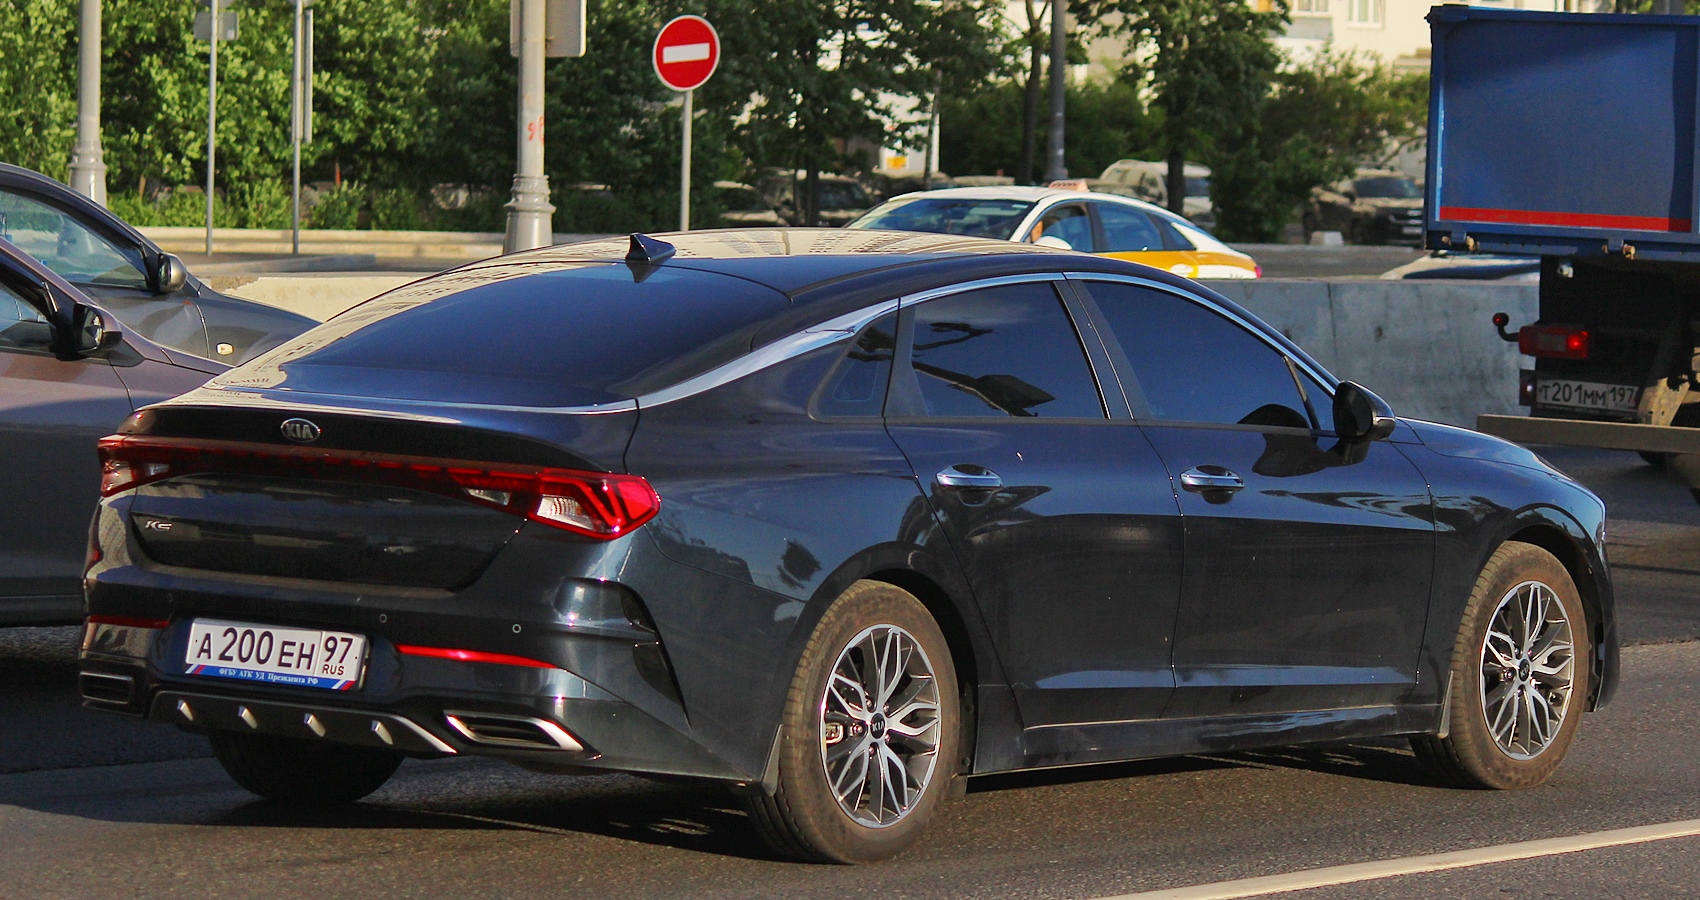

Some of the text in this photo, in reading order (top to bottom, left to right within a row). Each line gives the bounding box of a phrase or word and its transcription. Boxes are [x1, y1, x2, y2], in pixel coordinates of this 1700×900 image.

[1609, 386, 1635, 403] 197
[285, 423, 314, 439] KIA
[324, 636, 353, 664] 97
[219, 667, 319, 685] ФГБУ АТК УД Президента РФ
[322, 664, 344, 675] RUS
[872, 720, 885, 732] KIA
